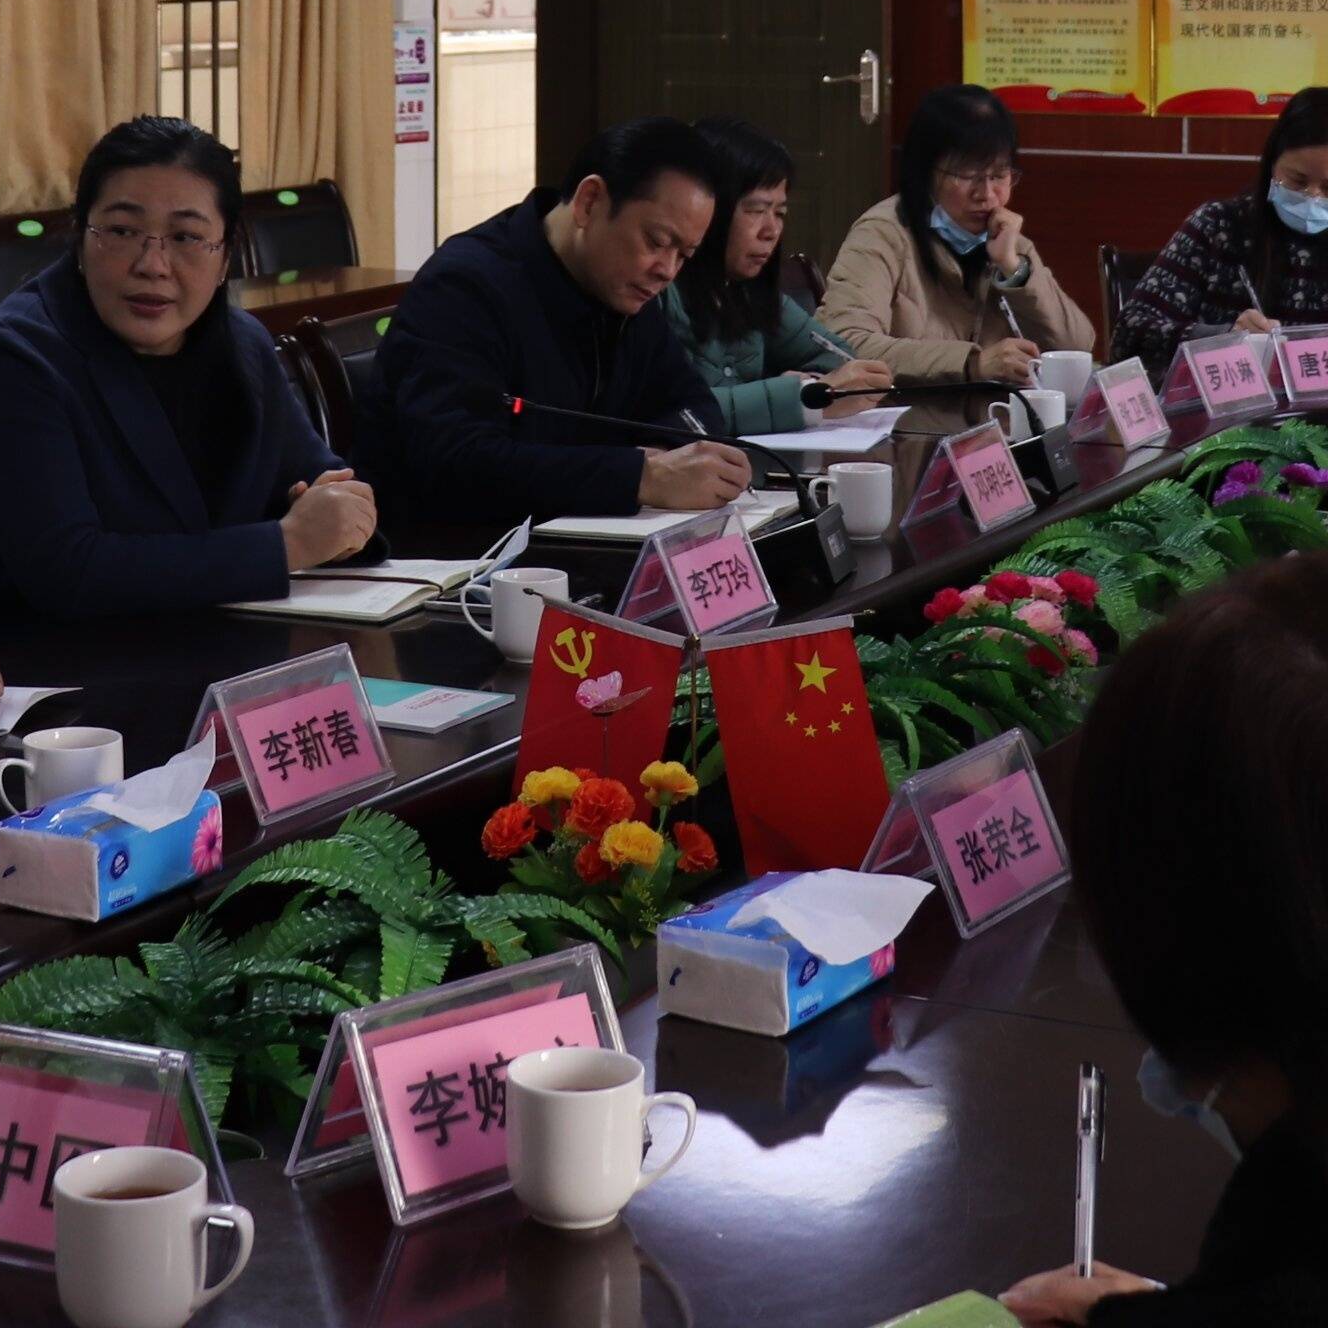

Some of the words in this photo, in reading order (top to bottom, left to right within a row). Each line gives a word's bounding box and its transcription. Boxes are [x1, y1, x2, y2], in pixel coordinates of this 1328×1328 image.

[686, 553, 752, 609] 李巧玲
[259, 709, 360, 781] 李新春
[955, 806, 1042, 885] 张荣全
